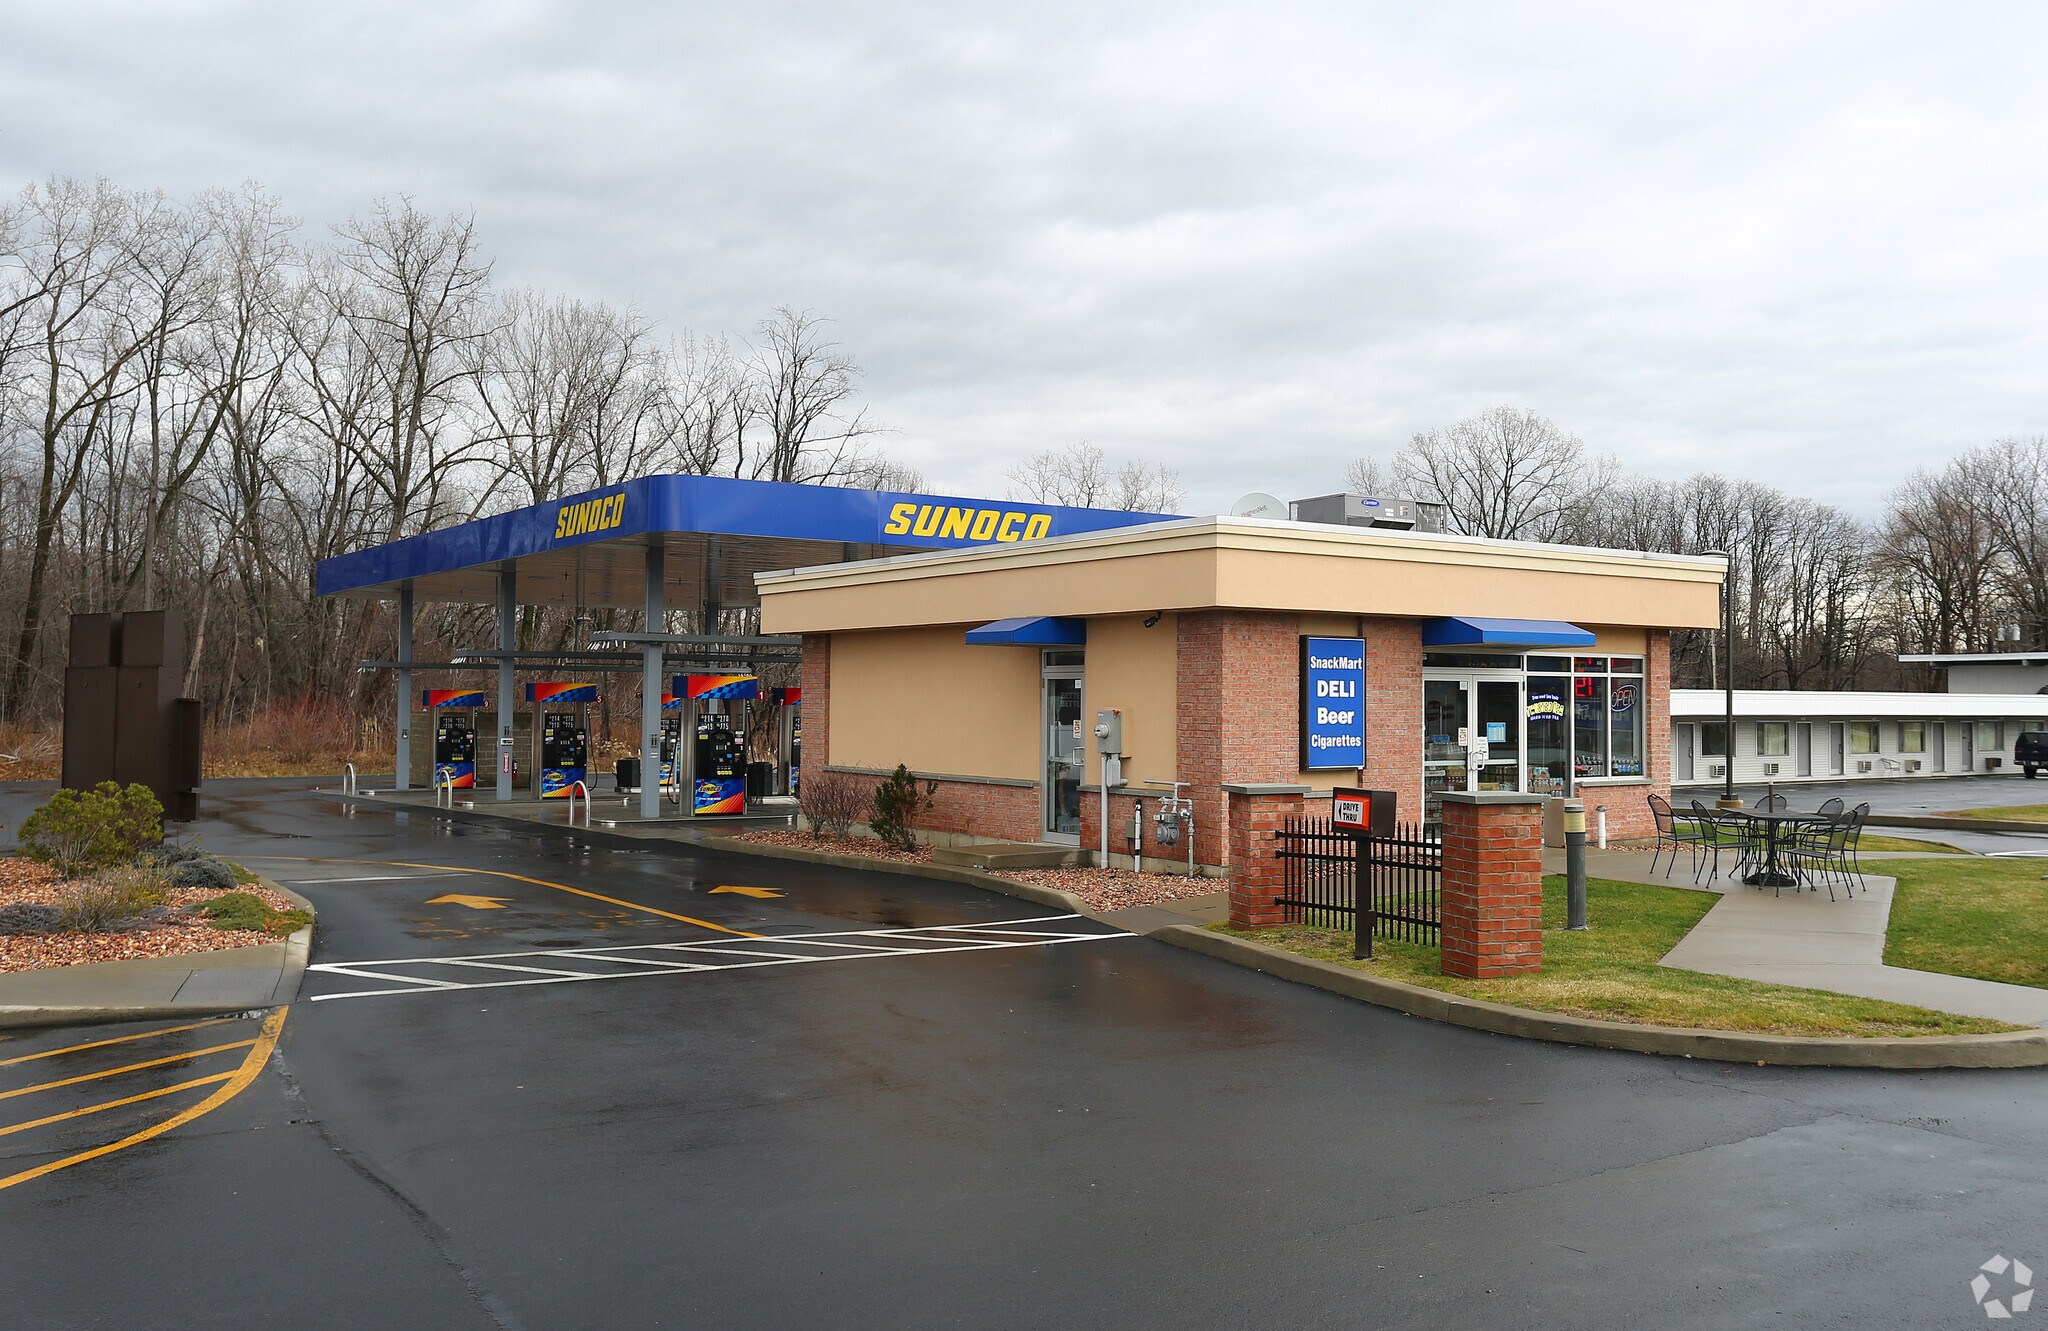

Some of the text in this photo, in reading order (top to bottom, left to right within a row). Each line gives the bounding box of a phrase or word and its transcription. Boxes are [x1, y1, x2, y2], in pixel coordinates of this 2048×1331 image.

[555, 493, 626, 539] SUNOCO
[884, 503, 1053, 543] SUNOCO
[1310, 656, 1363, 670] SnackMart
[1317, 680, 1355, 698] DELI
[1611, 689, 1636, 708] OPEN
[1317, 707, 1355, 725] Beer
[1311, 734, 1362, 750] Cigarettes
[1342, 802, 1360, 812] DRIVE
[1342, 812, 1358, 822] THRU
